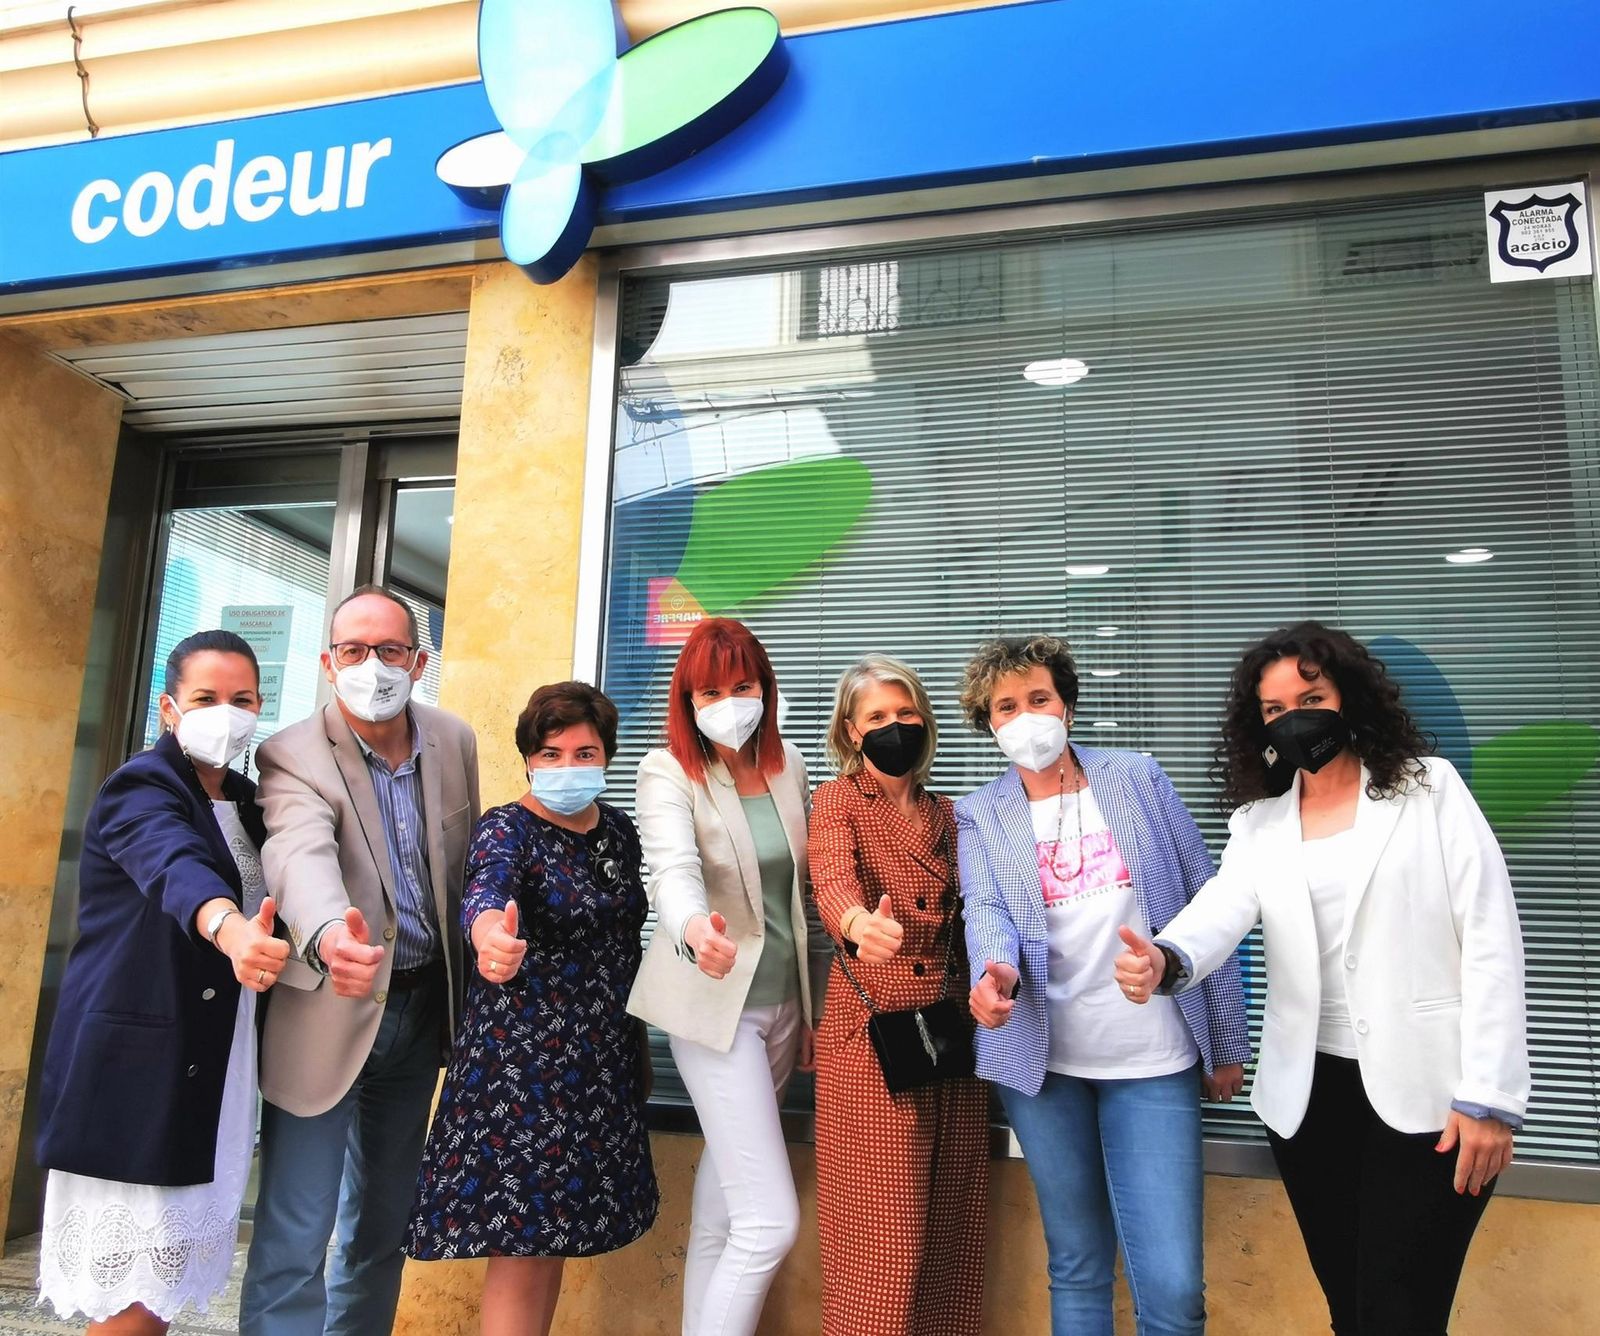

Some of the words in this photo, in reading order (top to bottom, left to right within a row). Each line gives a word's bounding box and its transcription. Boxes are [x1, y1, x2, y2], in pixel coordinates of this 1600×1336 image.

[71, 137, 392, 244] codeur
[1519, 209, 1553, 217] ALARMA
[1512, 216, 1562, 225] CONECTADA
[1510, 238, 1567, 253] acacio
